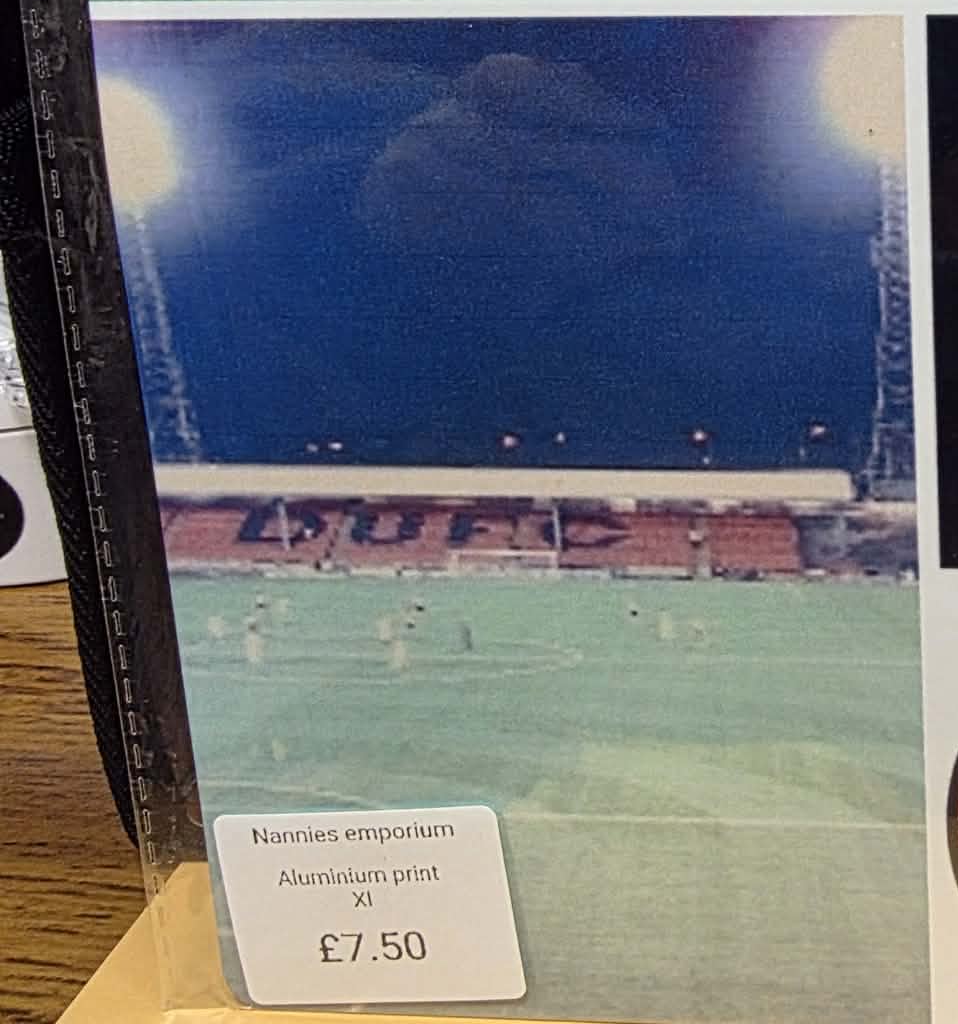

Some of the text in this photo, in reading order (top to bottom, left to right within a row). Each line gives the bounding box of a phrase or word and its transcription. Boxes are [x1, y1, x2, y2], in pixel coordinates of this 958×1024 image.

[252, 822, 455, 845] Nannies emporium
[279, 865, 440, 887] Aluminium print
[320, 931, 427, 963] £7.50
